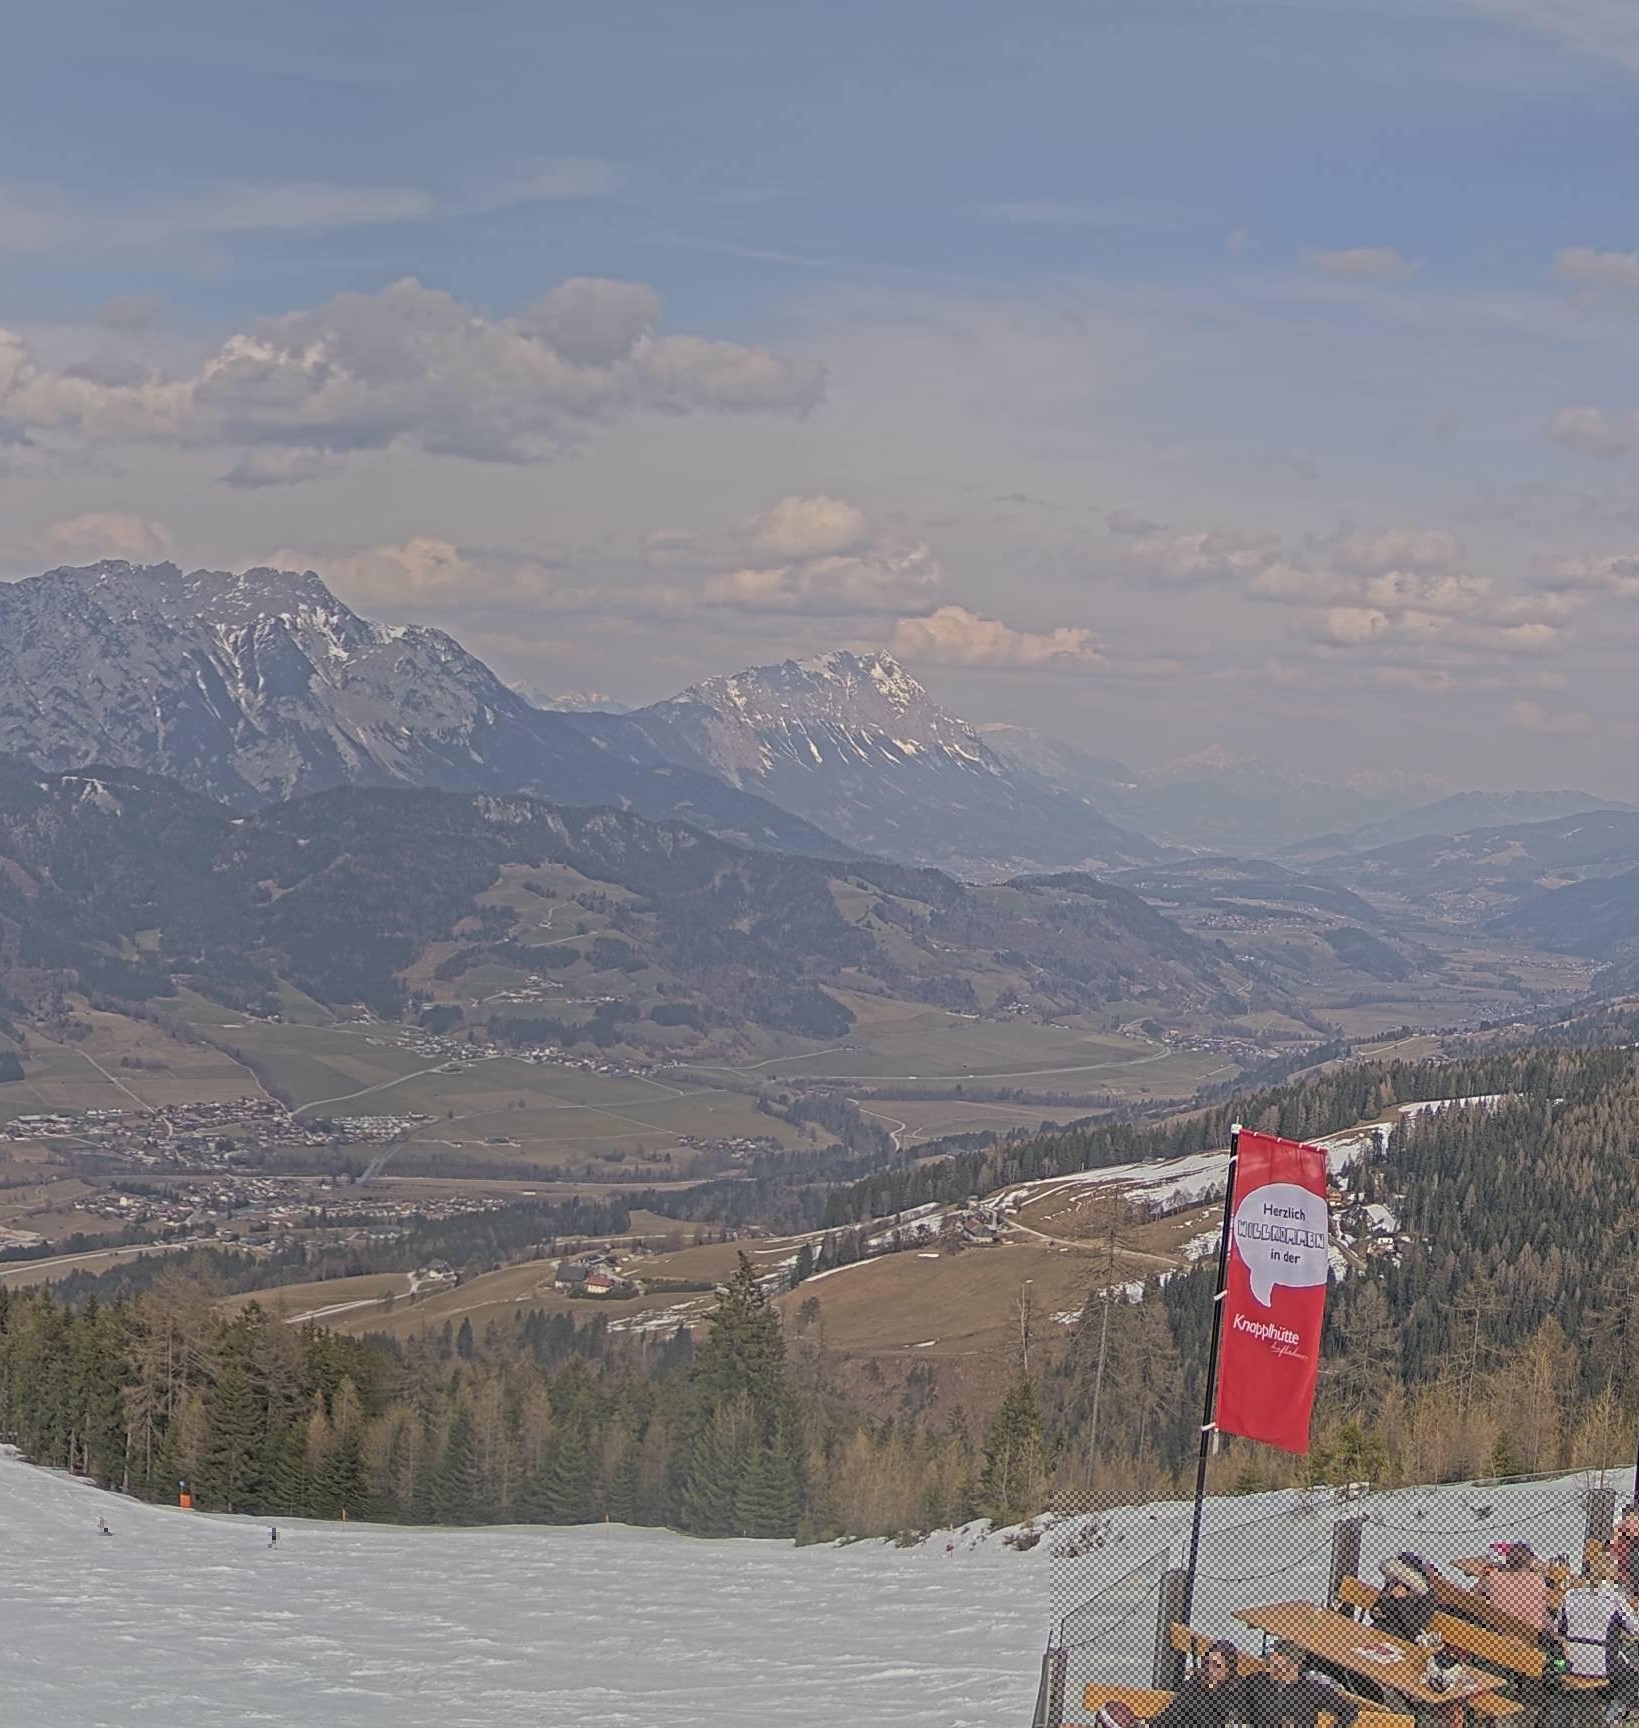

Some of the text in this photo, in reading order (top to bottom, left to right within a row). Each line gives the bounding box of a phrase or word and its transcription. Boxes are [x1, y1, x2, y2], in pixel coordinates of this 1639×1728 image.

[1263, 1203, 1306, 1221] Herzlich
[1238, 1220, 1325, 1248] WILLKOMMEN
[1271, 1249, 1300, 1264] in der
[1233, 1314, 1299, 1344] Knapplhütte
